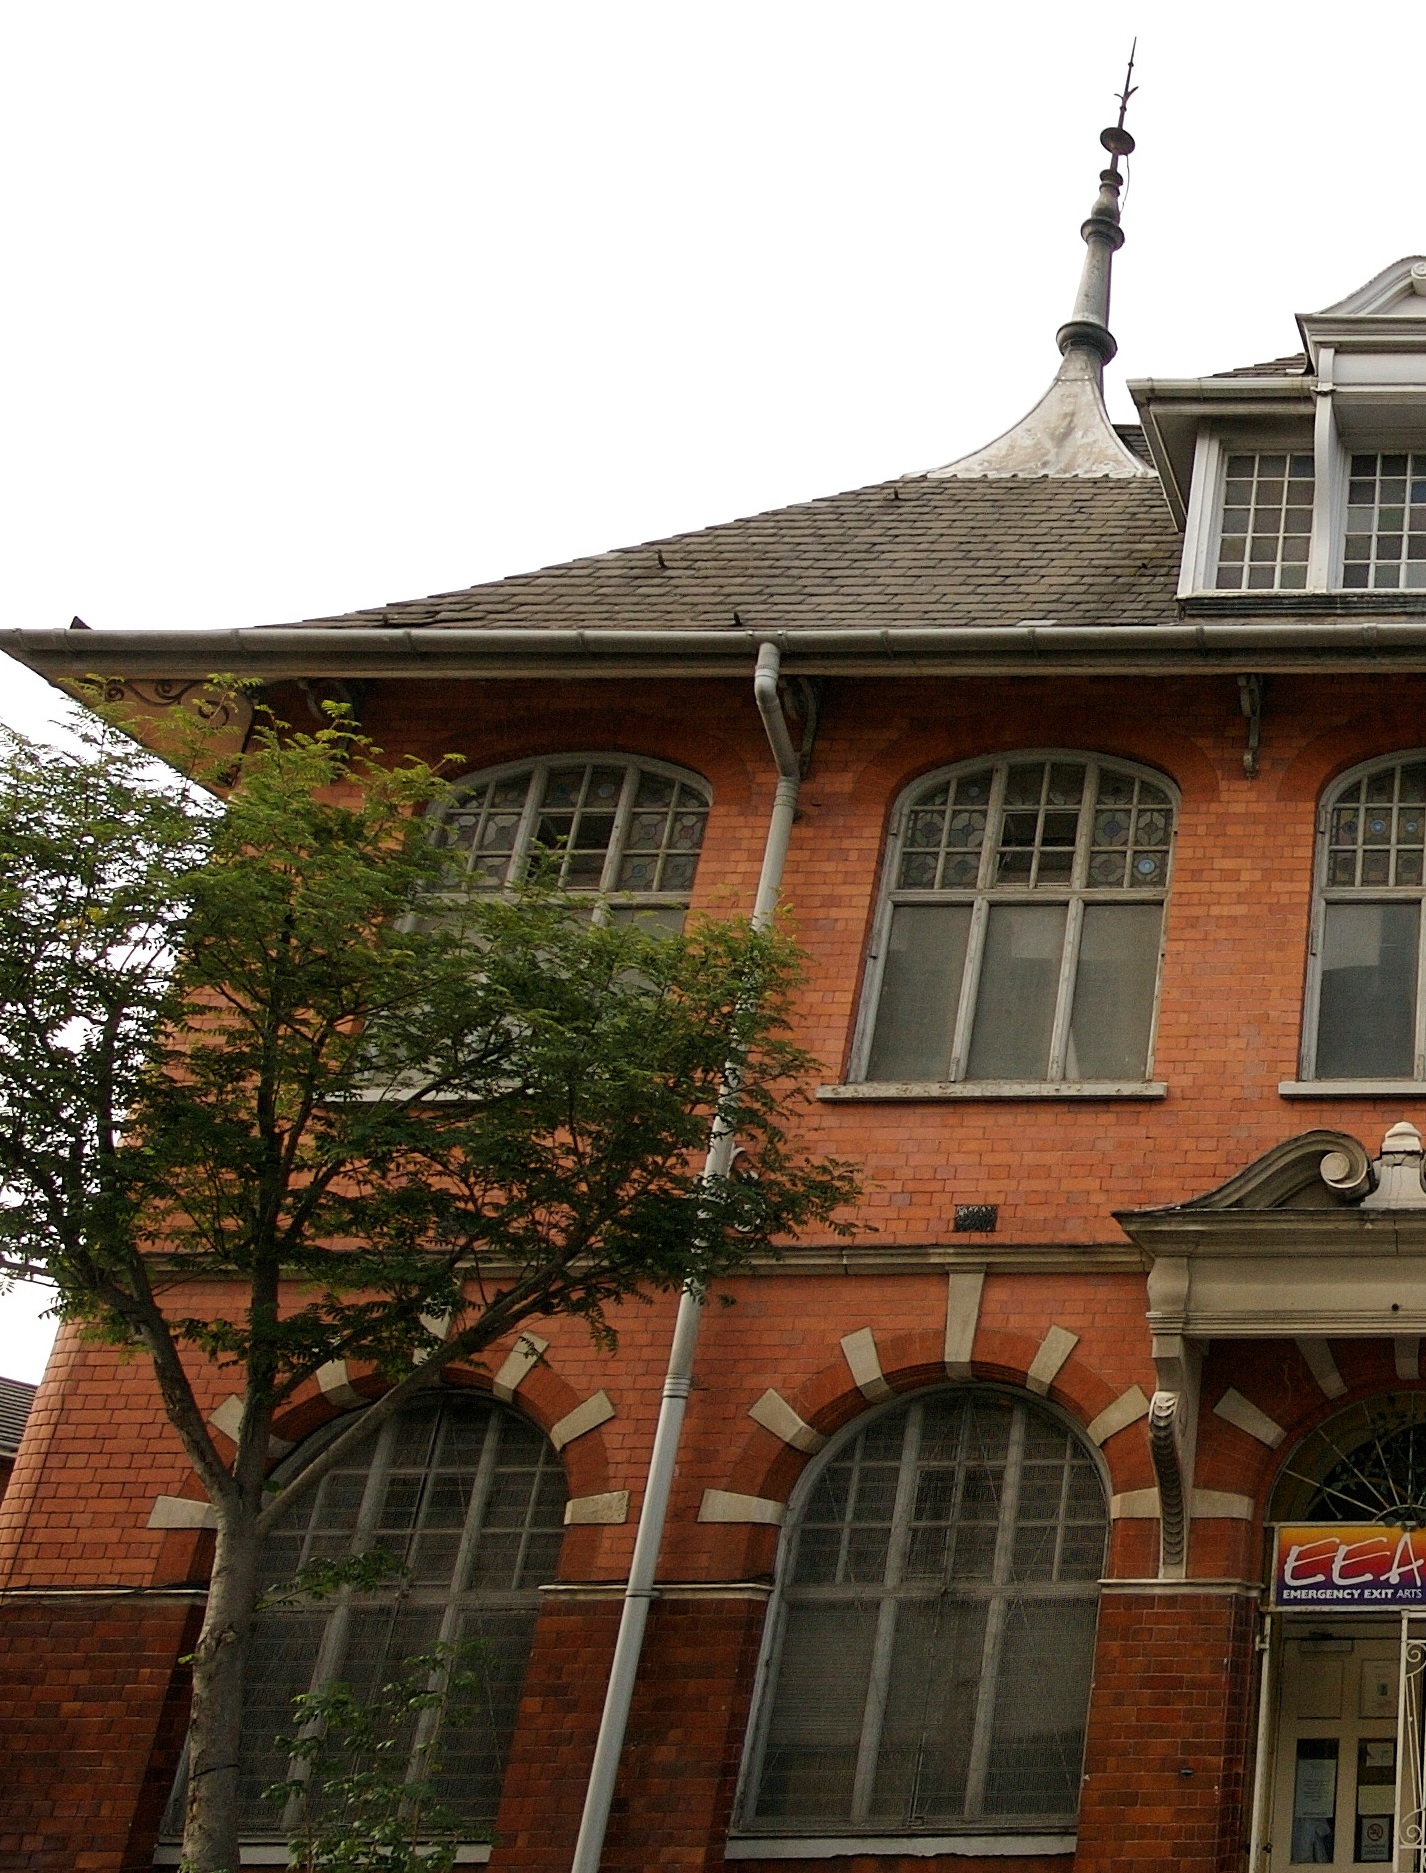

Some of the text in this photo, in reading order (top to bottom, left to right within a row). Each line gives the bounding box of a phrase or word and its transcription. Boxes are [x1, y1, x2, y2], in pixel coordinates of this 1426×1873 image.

[1284, 1532, 1425, 1588] EEA
[1283, 1589, 1423, 1599] EMERGENCY EXIT ARTS
